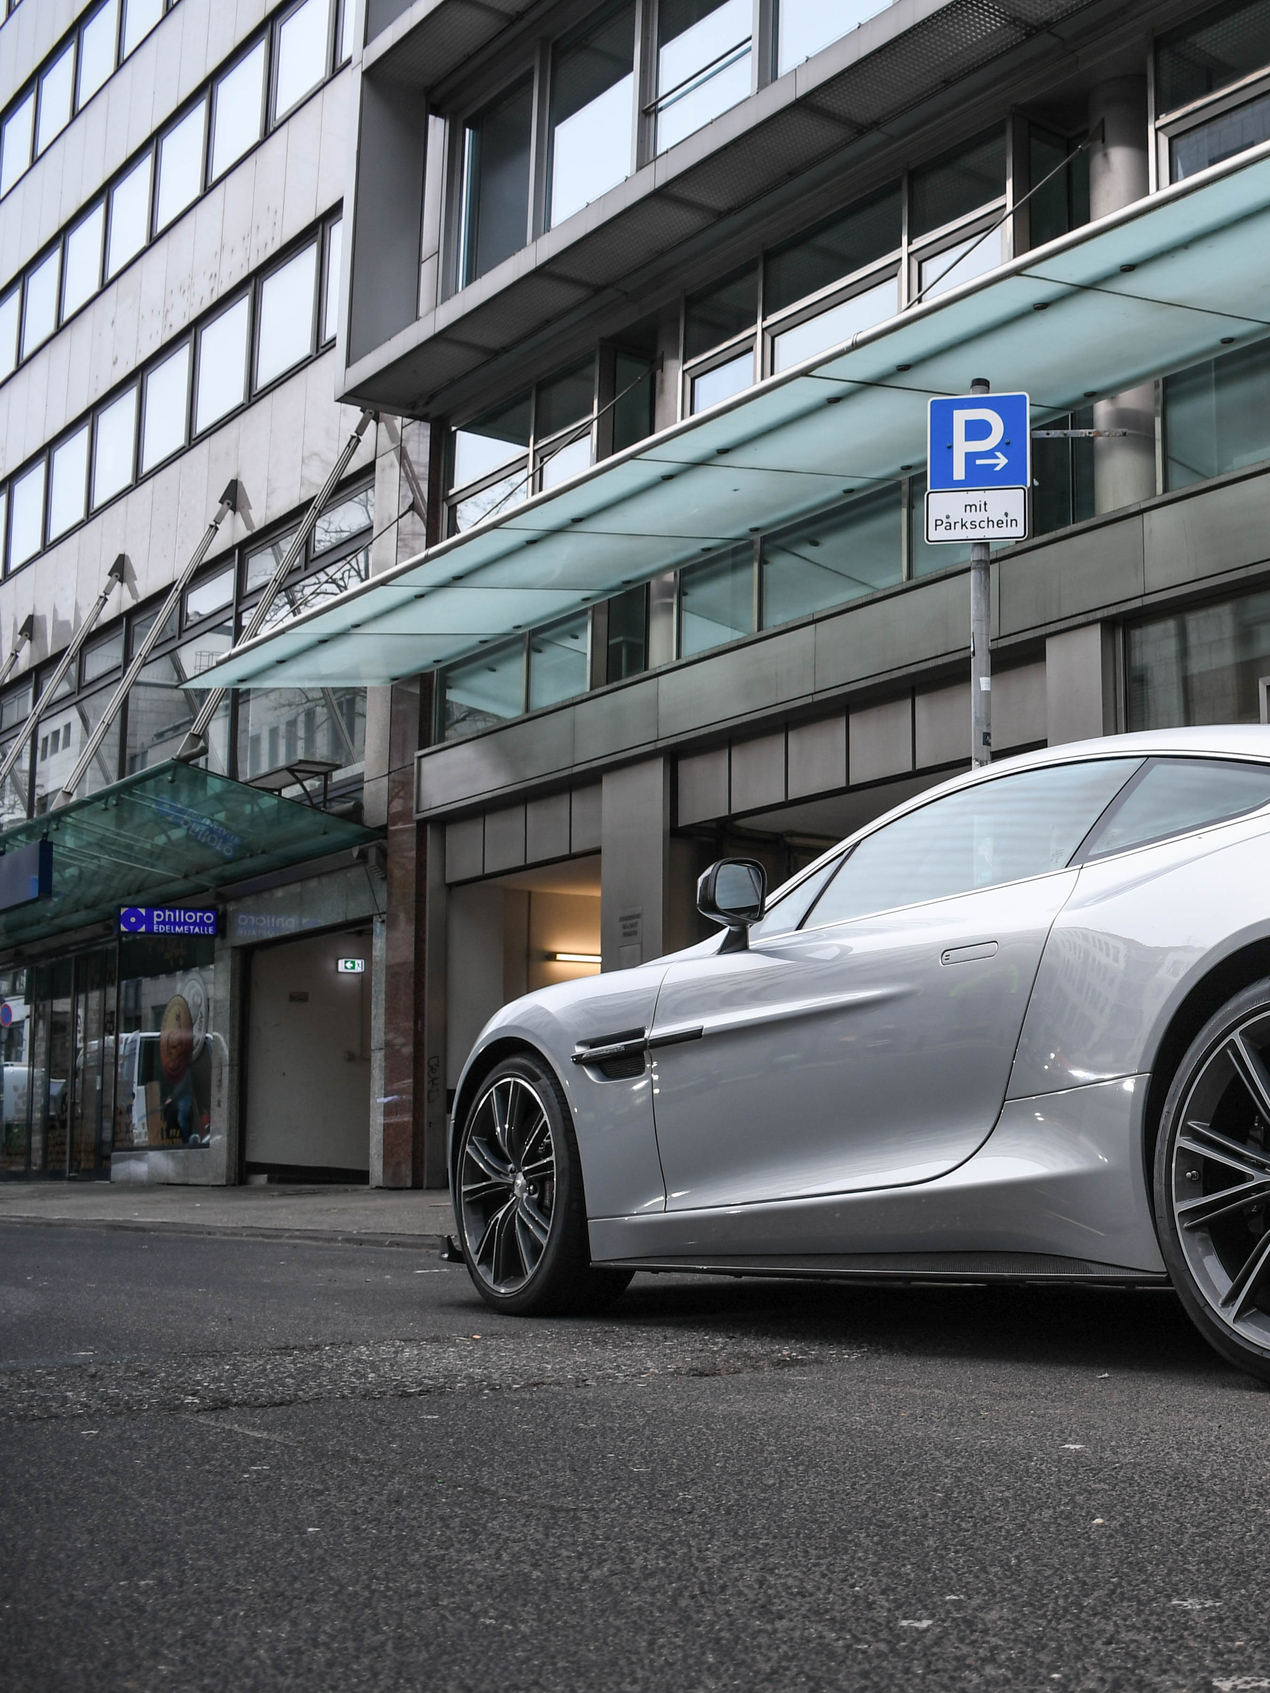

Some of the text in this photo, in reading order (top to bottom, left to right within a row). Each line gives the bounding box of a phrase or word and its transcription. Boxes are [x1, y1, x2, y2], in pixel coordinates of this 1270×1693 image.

[953, 408, 1004, 480] P
[964, 500, 988, 514] mit
[934, 514, 1018, 531] Parkschein
[153, 909, 214, 924] philoro
[153, 924, 214, 935] EDELMETALLE
